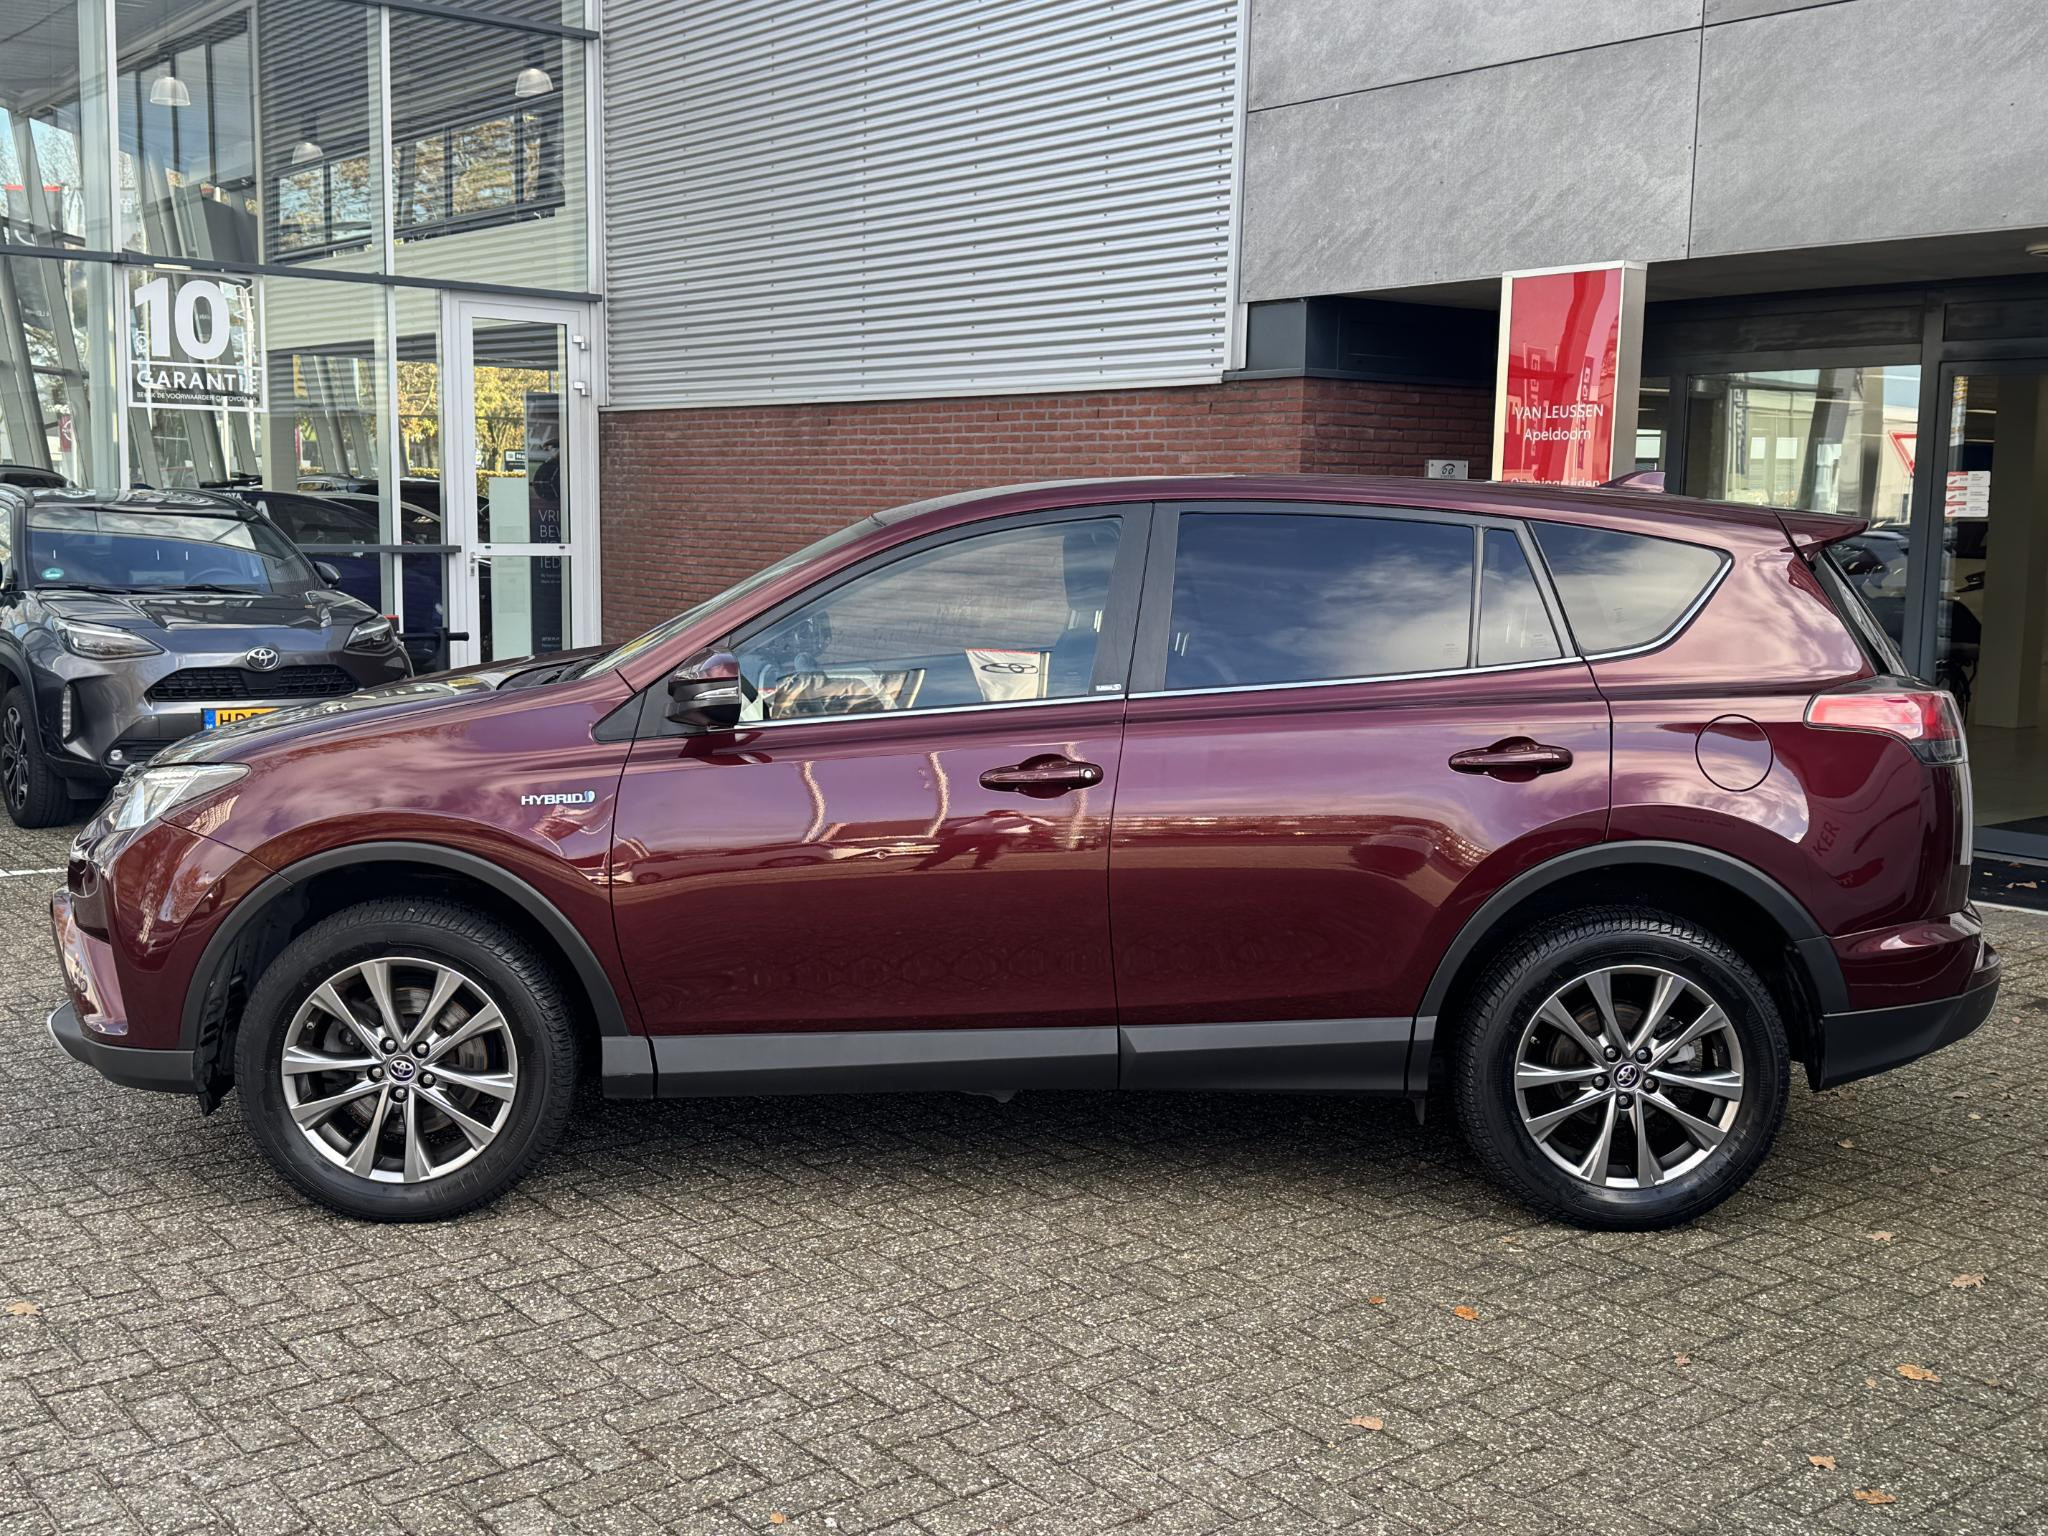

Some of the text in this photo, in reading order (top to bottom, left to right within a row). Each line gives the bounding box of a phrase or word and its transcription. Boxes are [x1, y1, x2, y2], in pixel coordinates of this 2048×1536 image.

[134, 277, 230, 360] 10
[136, 370, 258, 394] GARANTIE
[1515, 404, 1603, 419] VAN LEUSSEN
[1524, 428, 1591, 444] Apeldoorn
[521, 793, 586, 805] HYBRID
